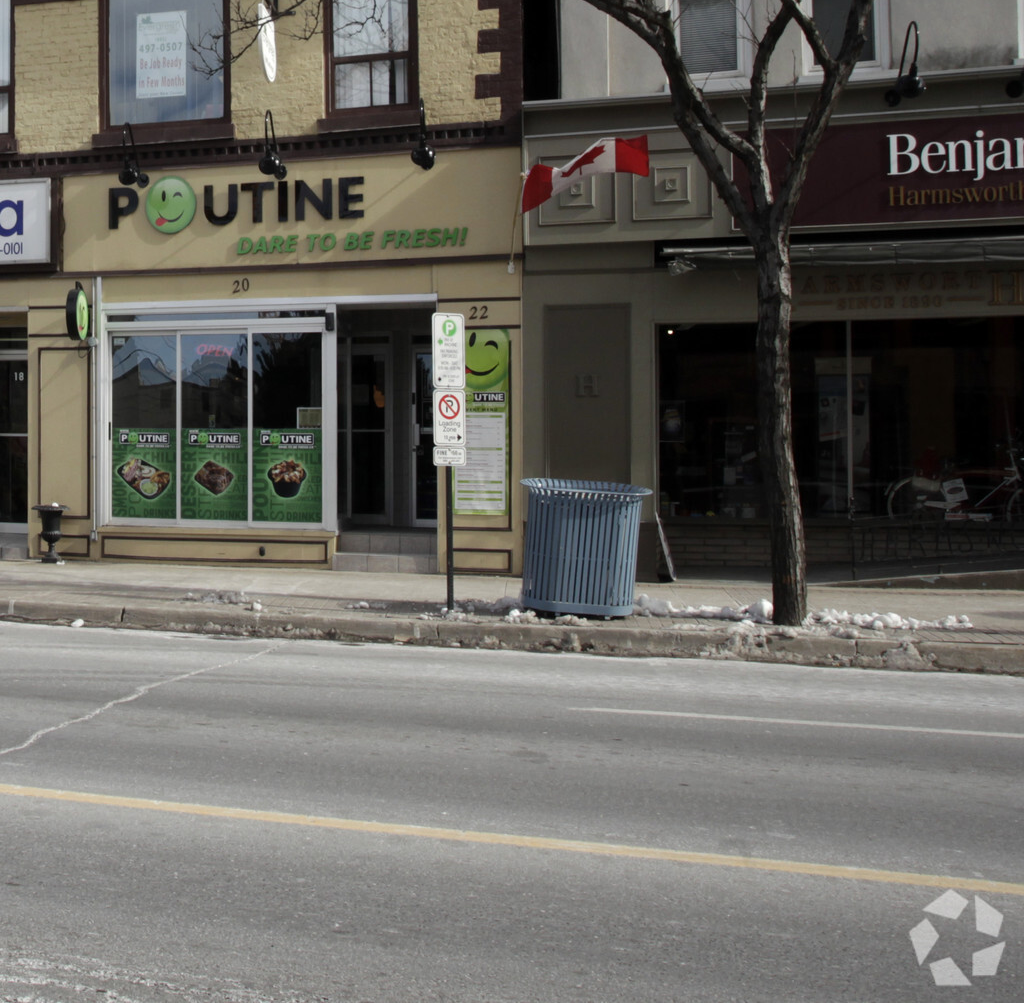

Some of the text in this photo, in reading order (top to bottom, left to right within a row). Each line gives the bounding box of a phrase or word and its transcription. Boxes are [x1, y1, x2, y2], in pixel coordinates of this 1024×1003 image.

[139, 42, 183, 53] 497-0507
[149, 57, 161, 69] Job
[162, 56, 183, 69] Ready
[146, 76, 159, 88] Few
[161, 75, 184, 87] Months
[236, 227, 469, 256] DARE TO BE FRESH!
[232, 277, 250, 294] 20
[837, 296, 894, 310] SINCE
[469, 305, 489, 320] 22
[196, 344, 234, 357] OPEN
[14, 372, 25, 381] 18
[438, 420, 461, 428] Loading
